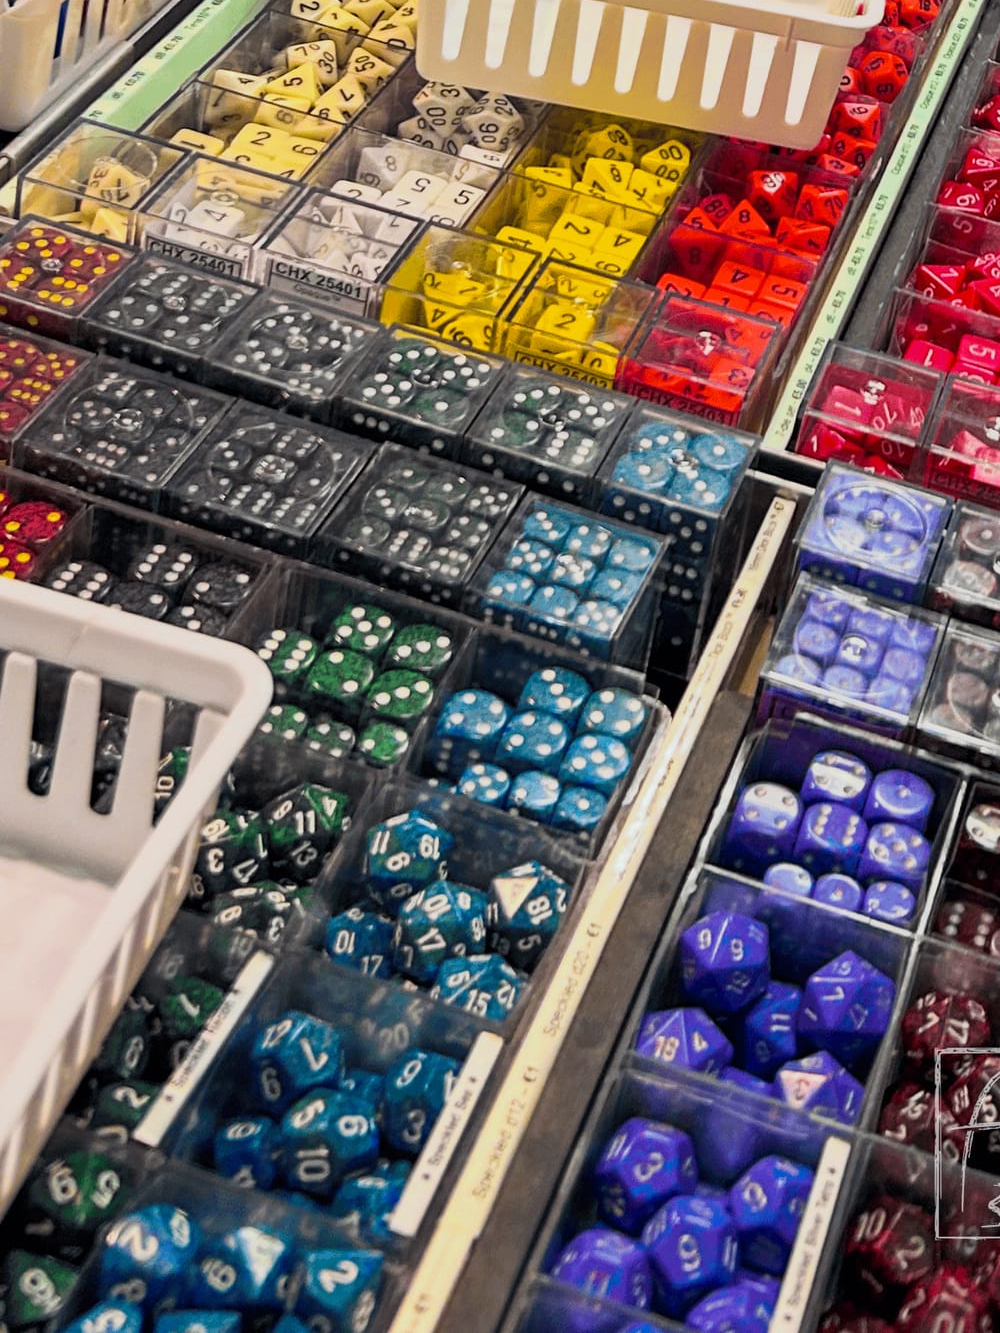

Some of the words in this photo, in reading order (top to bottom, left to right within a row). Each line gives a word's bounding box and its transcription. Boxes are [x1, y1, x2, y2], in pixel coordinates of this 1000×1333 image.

[283, 76, 303, 87] 5
[251, 132, 271, 146] 2
[453, 189, 475, 204] 5
[150, 241, 185, 263] CHX
[188, 248, 235, 274] 25401
[275, 262, 312, 282] CHX
[315, 272, 362, 298] 25401
[519, 355, 557, 373] CHX
[635, 387, 677, 409] CHX
[933, 472, 973, 496] CHX
